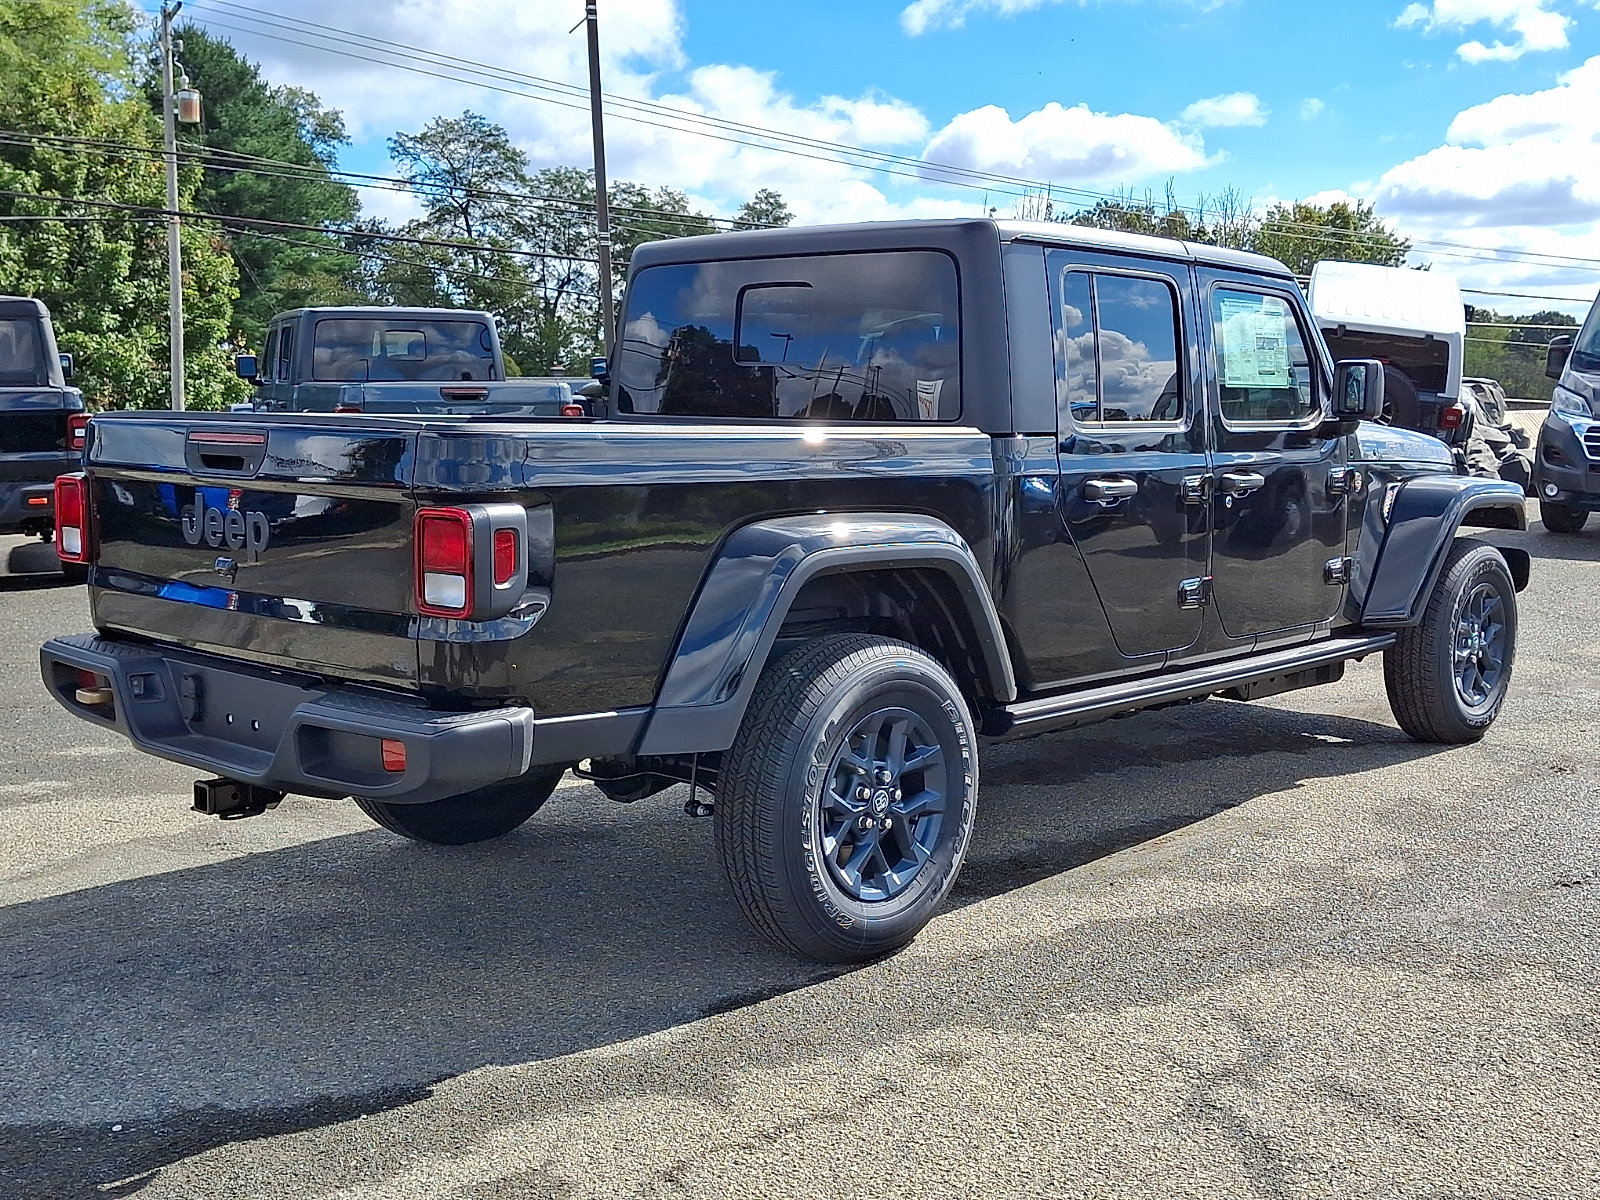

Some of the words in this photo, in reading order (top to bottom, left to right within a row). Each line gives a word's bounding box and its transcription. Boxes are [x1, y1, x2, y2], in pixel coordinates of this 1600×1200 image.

[1386, 441, 1451, 459] GLADIA
[182, 492, 270, 563] Jeep
[800, 718, 857, 930] BRIDGESTONE
